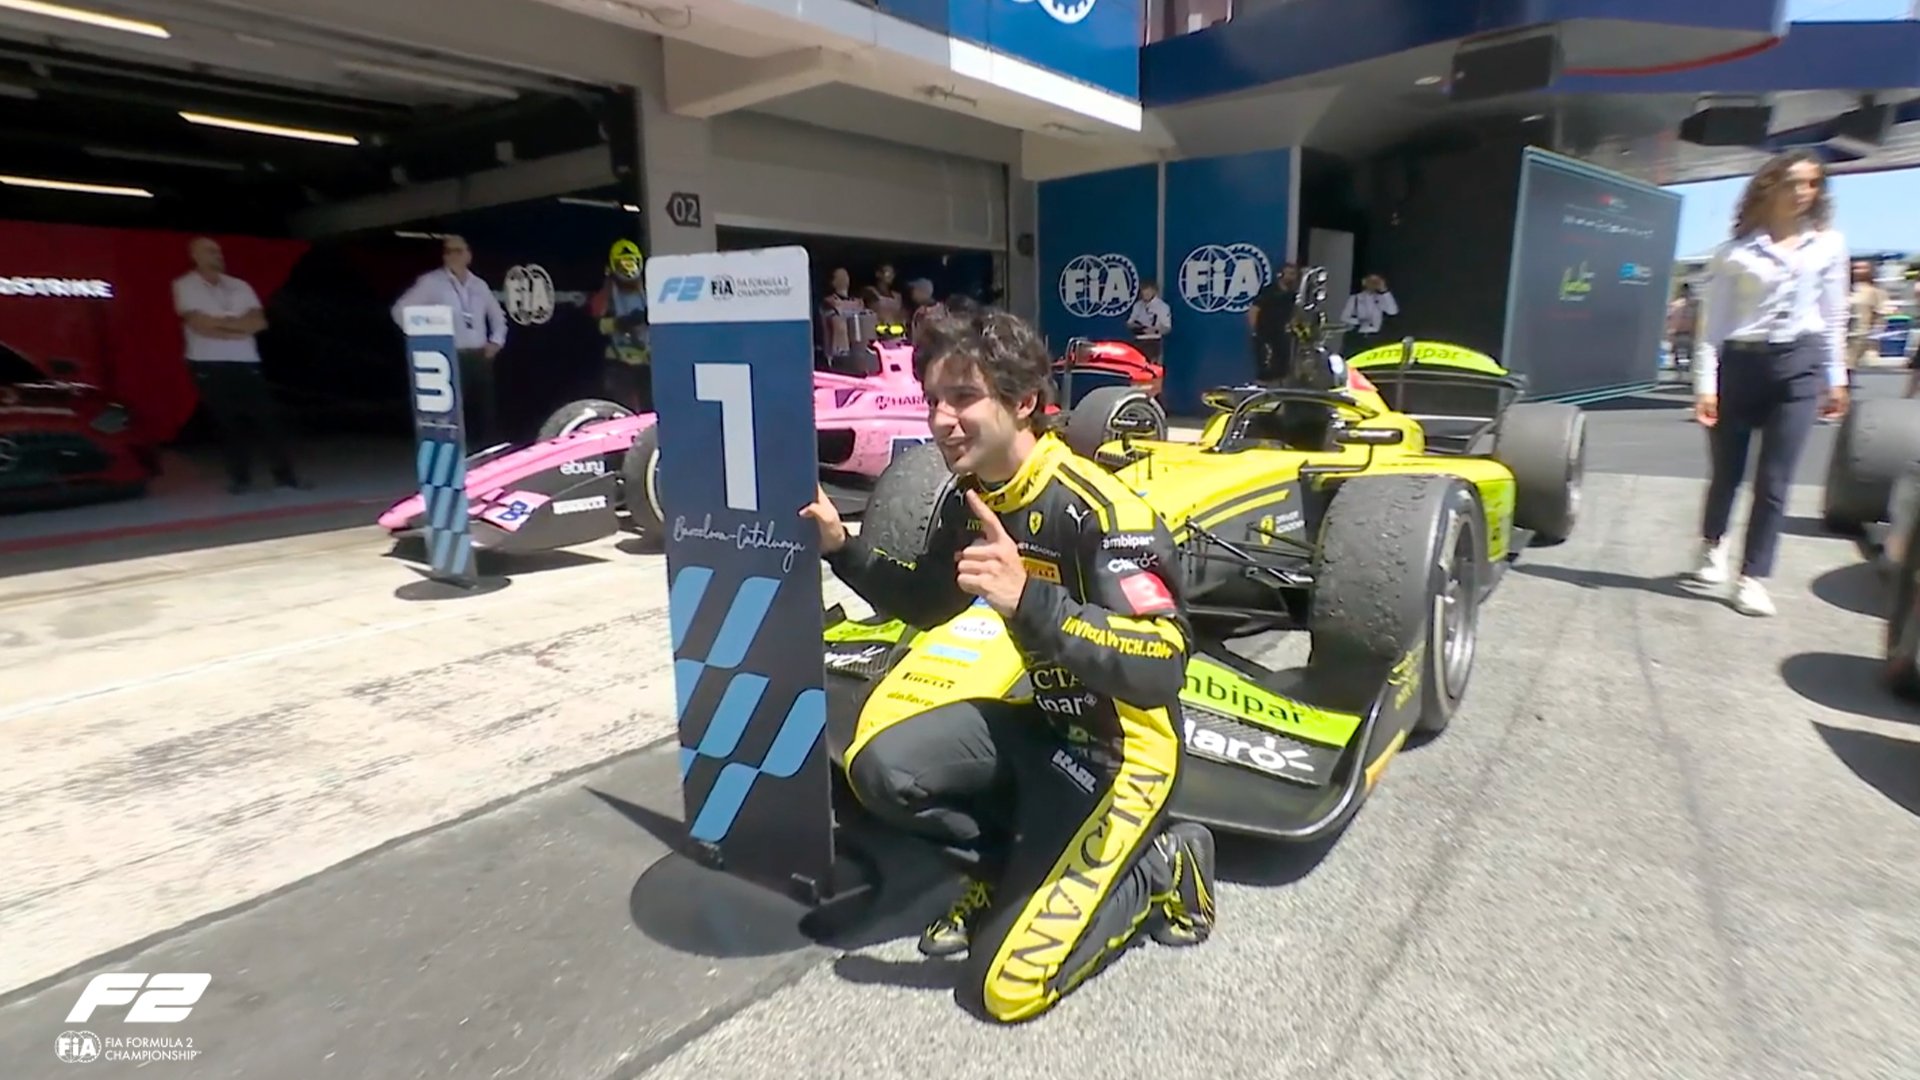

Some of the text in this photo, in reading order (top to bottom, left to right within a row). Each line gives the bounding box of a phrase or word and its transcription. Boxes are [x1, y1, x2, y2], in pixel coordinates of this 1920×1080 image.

[673, 197, 699, 223] 02
[658, 276, 705, 304] F2
[737, 287, 791, 298] CHAMPIONSHIP
[749, 277, 783, 288] FORMULA
[412, 351, 455, 413] 3
[694, 362, 760, 512] 1
[559, 460, 606, 476] ebury
[1102, 534, 1153, 550] ambipar
[997, 771, 1169, 985] INVICTA
